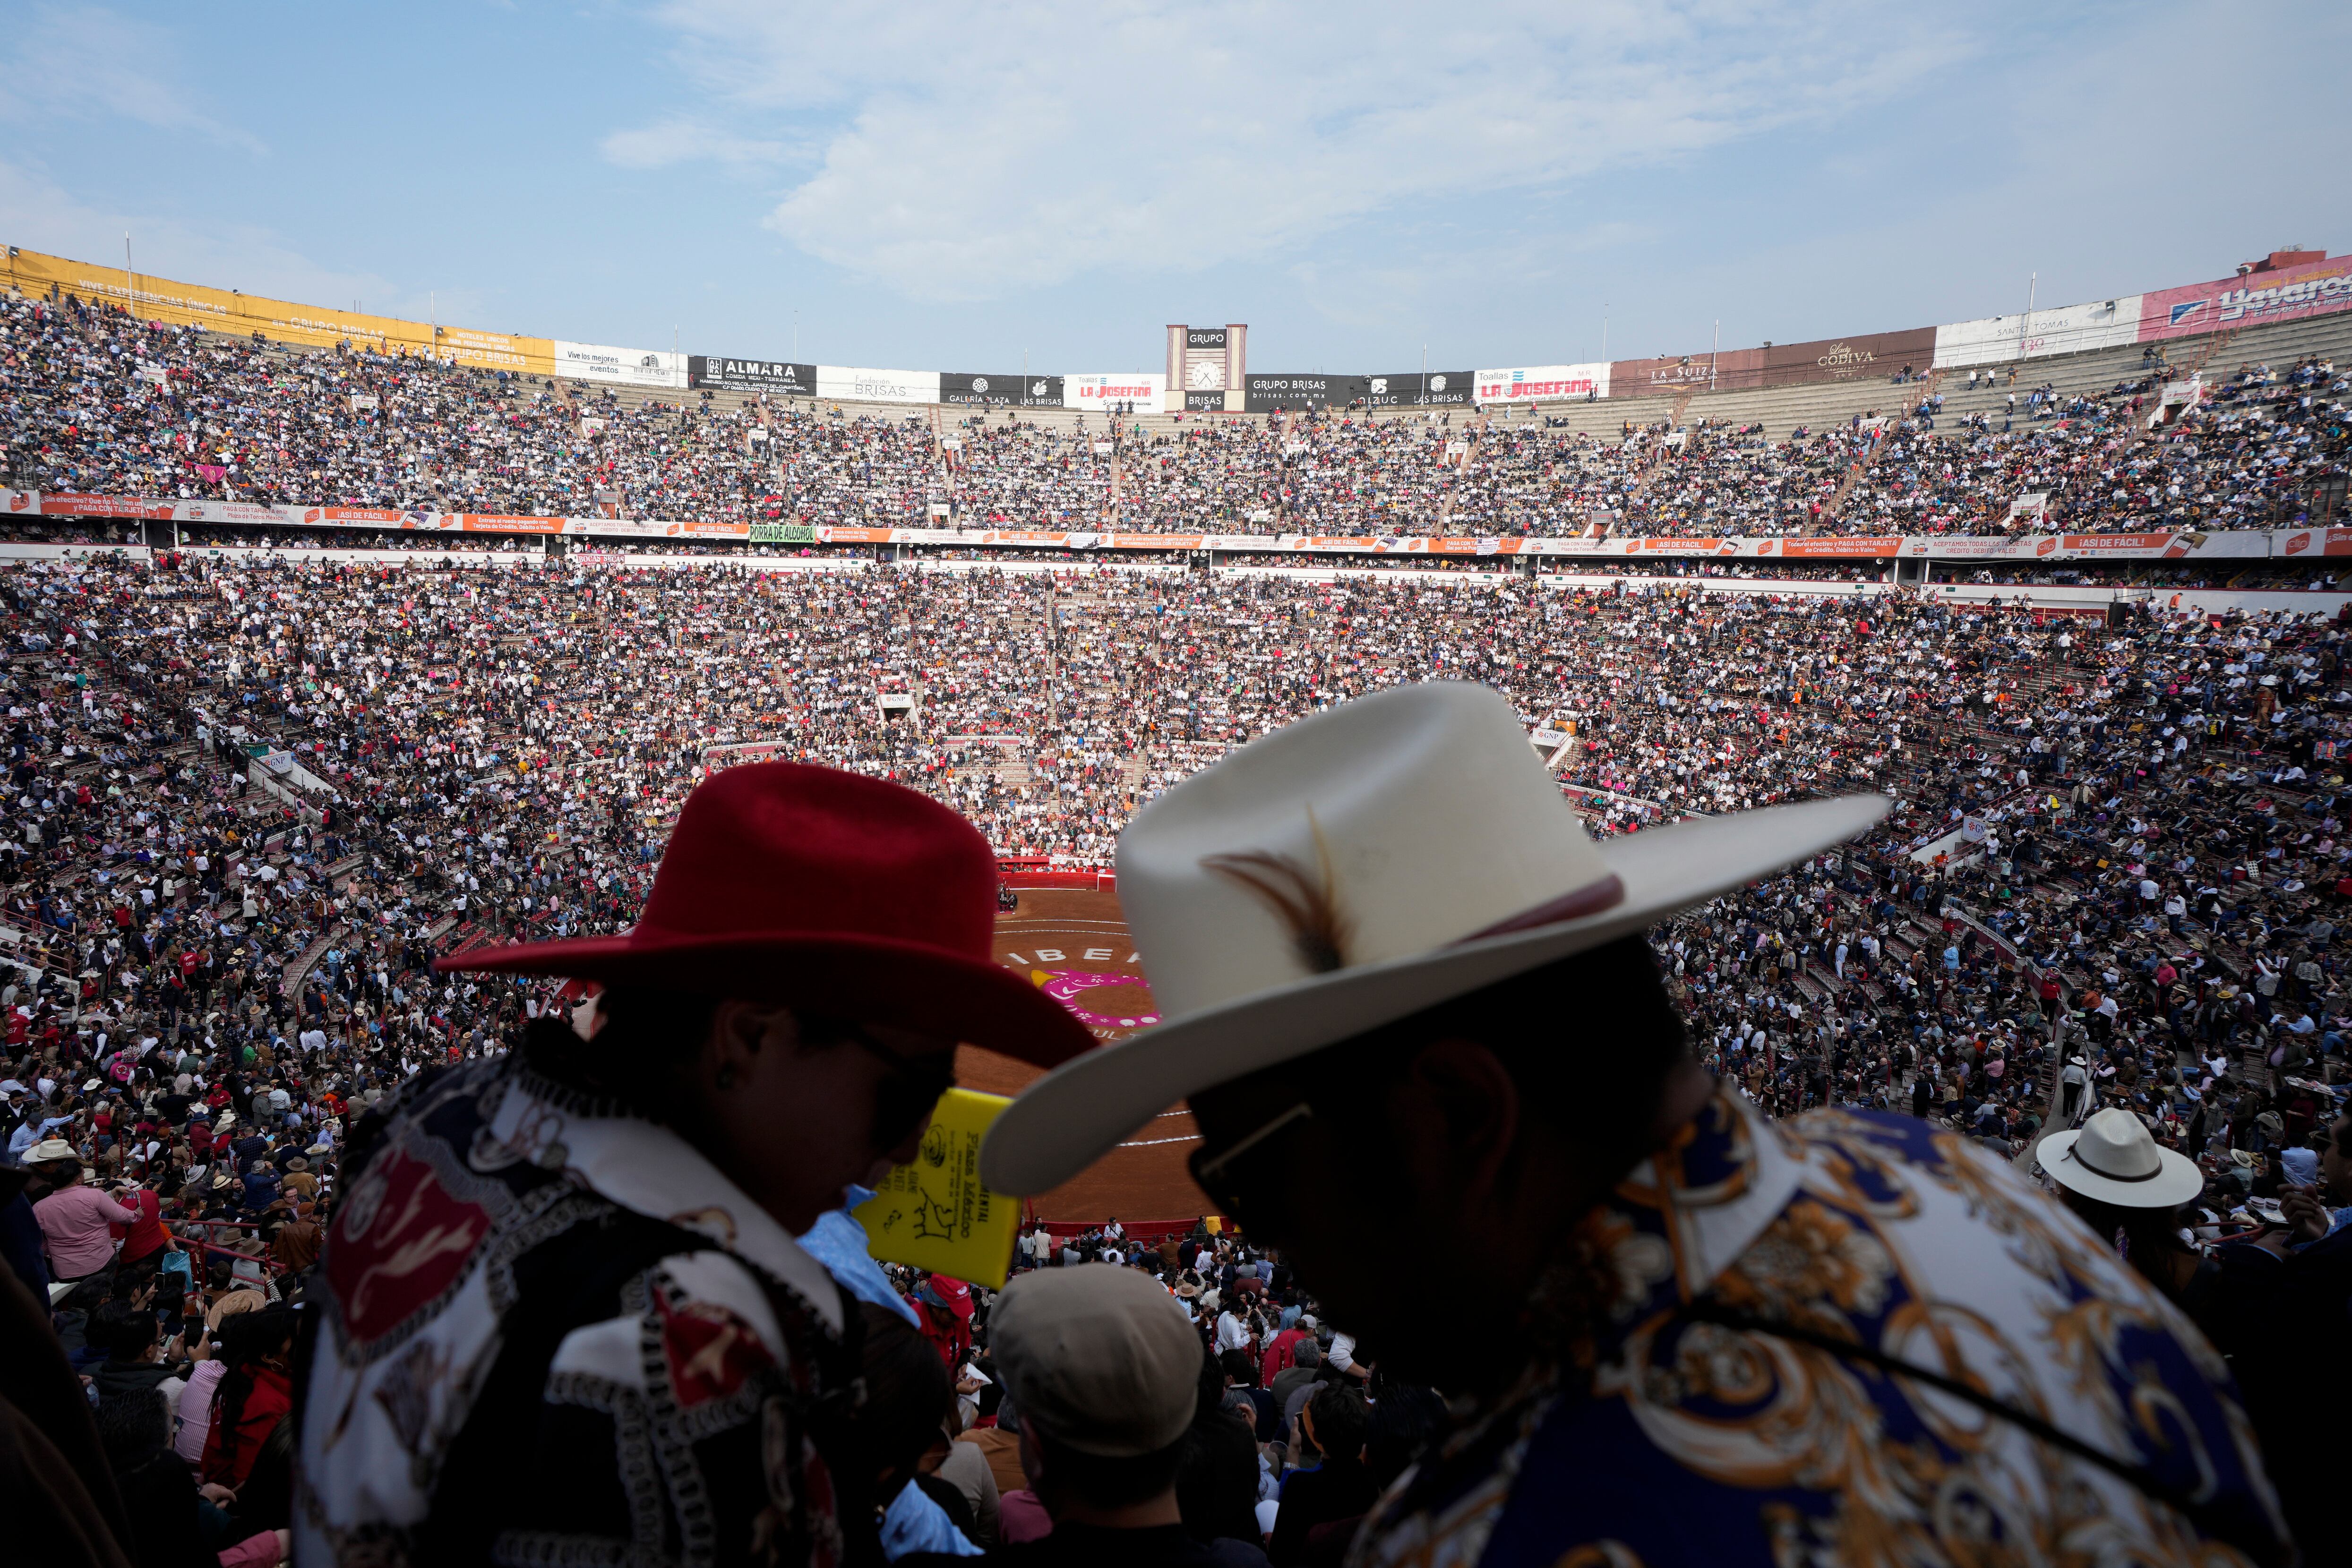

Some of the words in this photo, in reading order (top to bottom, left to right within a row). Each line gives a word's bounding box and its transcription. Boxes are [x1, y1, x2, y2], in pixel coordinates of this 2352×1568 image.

[78, 279, 105, 295] VIVE
[108, 284, 183, 308] EXPERIENCIAS
[291, 317, 338, 334] GRUPO
[342, 324, 385, 341] BRISAS
[1997, 325, 2028, 336] SANTO
[457, 332, 484, 341] HOTELES
[486, 335, 509, 344] UNICOS
[1190, 334, 1224, 344] GRUPO
[448, 338, 462, 346] PARA
[464, 340, 492, 349] PERSONAS
[494, 344, 515, 352] UNICAS
[1829, 343, 1852, 356] Lady
[440, 345, 483, 362] GRUPO
[486, 351, 526, 367] BRISAS
[567, 351, 581, 359] Vive
[582, 352, 591, 360] los
[592, 354, 619, 364] mejores
[1818, 351, 1875, 366] GODIVA
[589, 364, 619, 374] eventos
[726, 361, 796, 377] ALMARA
[1651, 370, 1667, 379] LA
[1678, 367, 1718, 378] SUIZA
[856, 375, 890, 385] Fundación
[1479, 372, 1509, 381] Toallas
[855, 384, 906, 397] BRISAS
[1253, 381, 1288, 391] GRUPO
[1292, 380, 1326, 391] BRISAS
[1481, 385, 1501, 397] LA
[1081, 386, 1093, 397] LA
[1189, 396, 1221, 407] BRISAS
[1414, 395, 1429, 403] LAS
[1433, 394, 1463, 403] BRISAS
[40, 496, 52, 505] ¿Sin
[337, 510, 352, 519] ¡ASÍ
[364, 511, 386, 520] FÁCIL!
[717, 524, 736, 532] FÁCIL!
[750, 526, 773, 540] PORRA
[774, 526, 783, 540] DE
[784, 526, 814, 541] ALCOHOL
[2079, 537, 2099, 548] ¡ASÍ
[2100, 539, 2112, 547] DE
[2114, 536, 2146, 547] FÁCIL!
[2287, 538, 2309, 549] clip
[2326, 533, 2347, 543] ¿Sin
[1656, 540, 1671, 548] ¡ASÍ
[1759, 544, 1772, 552] clip
[2038, 542, 2055, 552] clip
[271, 756, 285, 766] GNP
